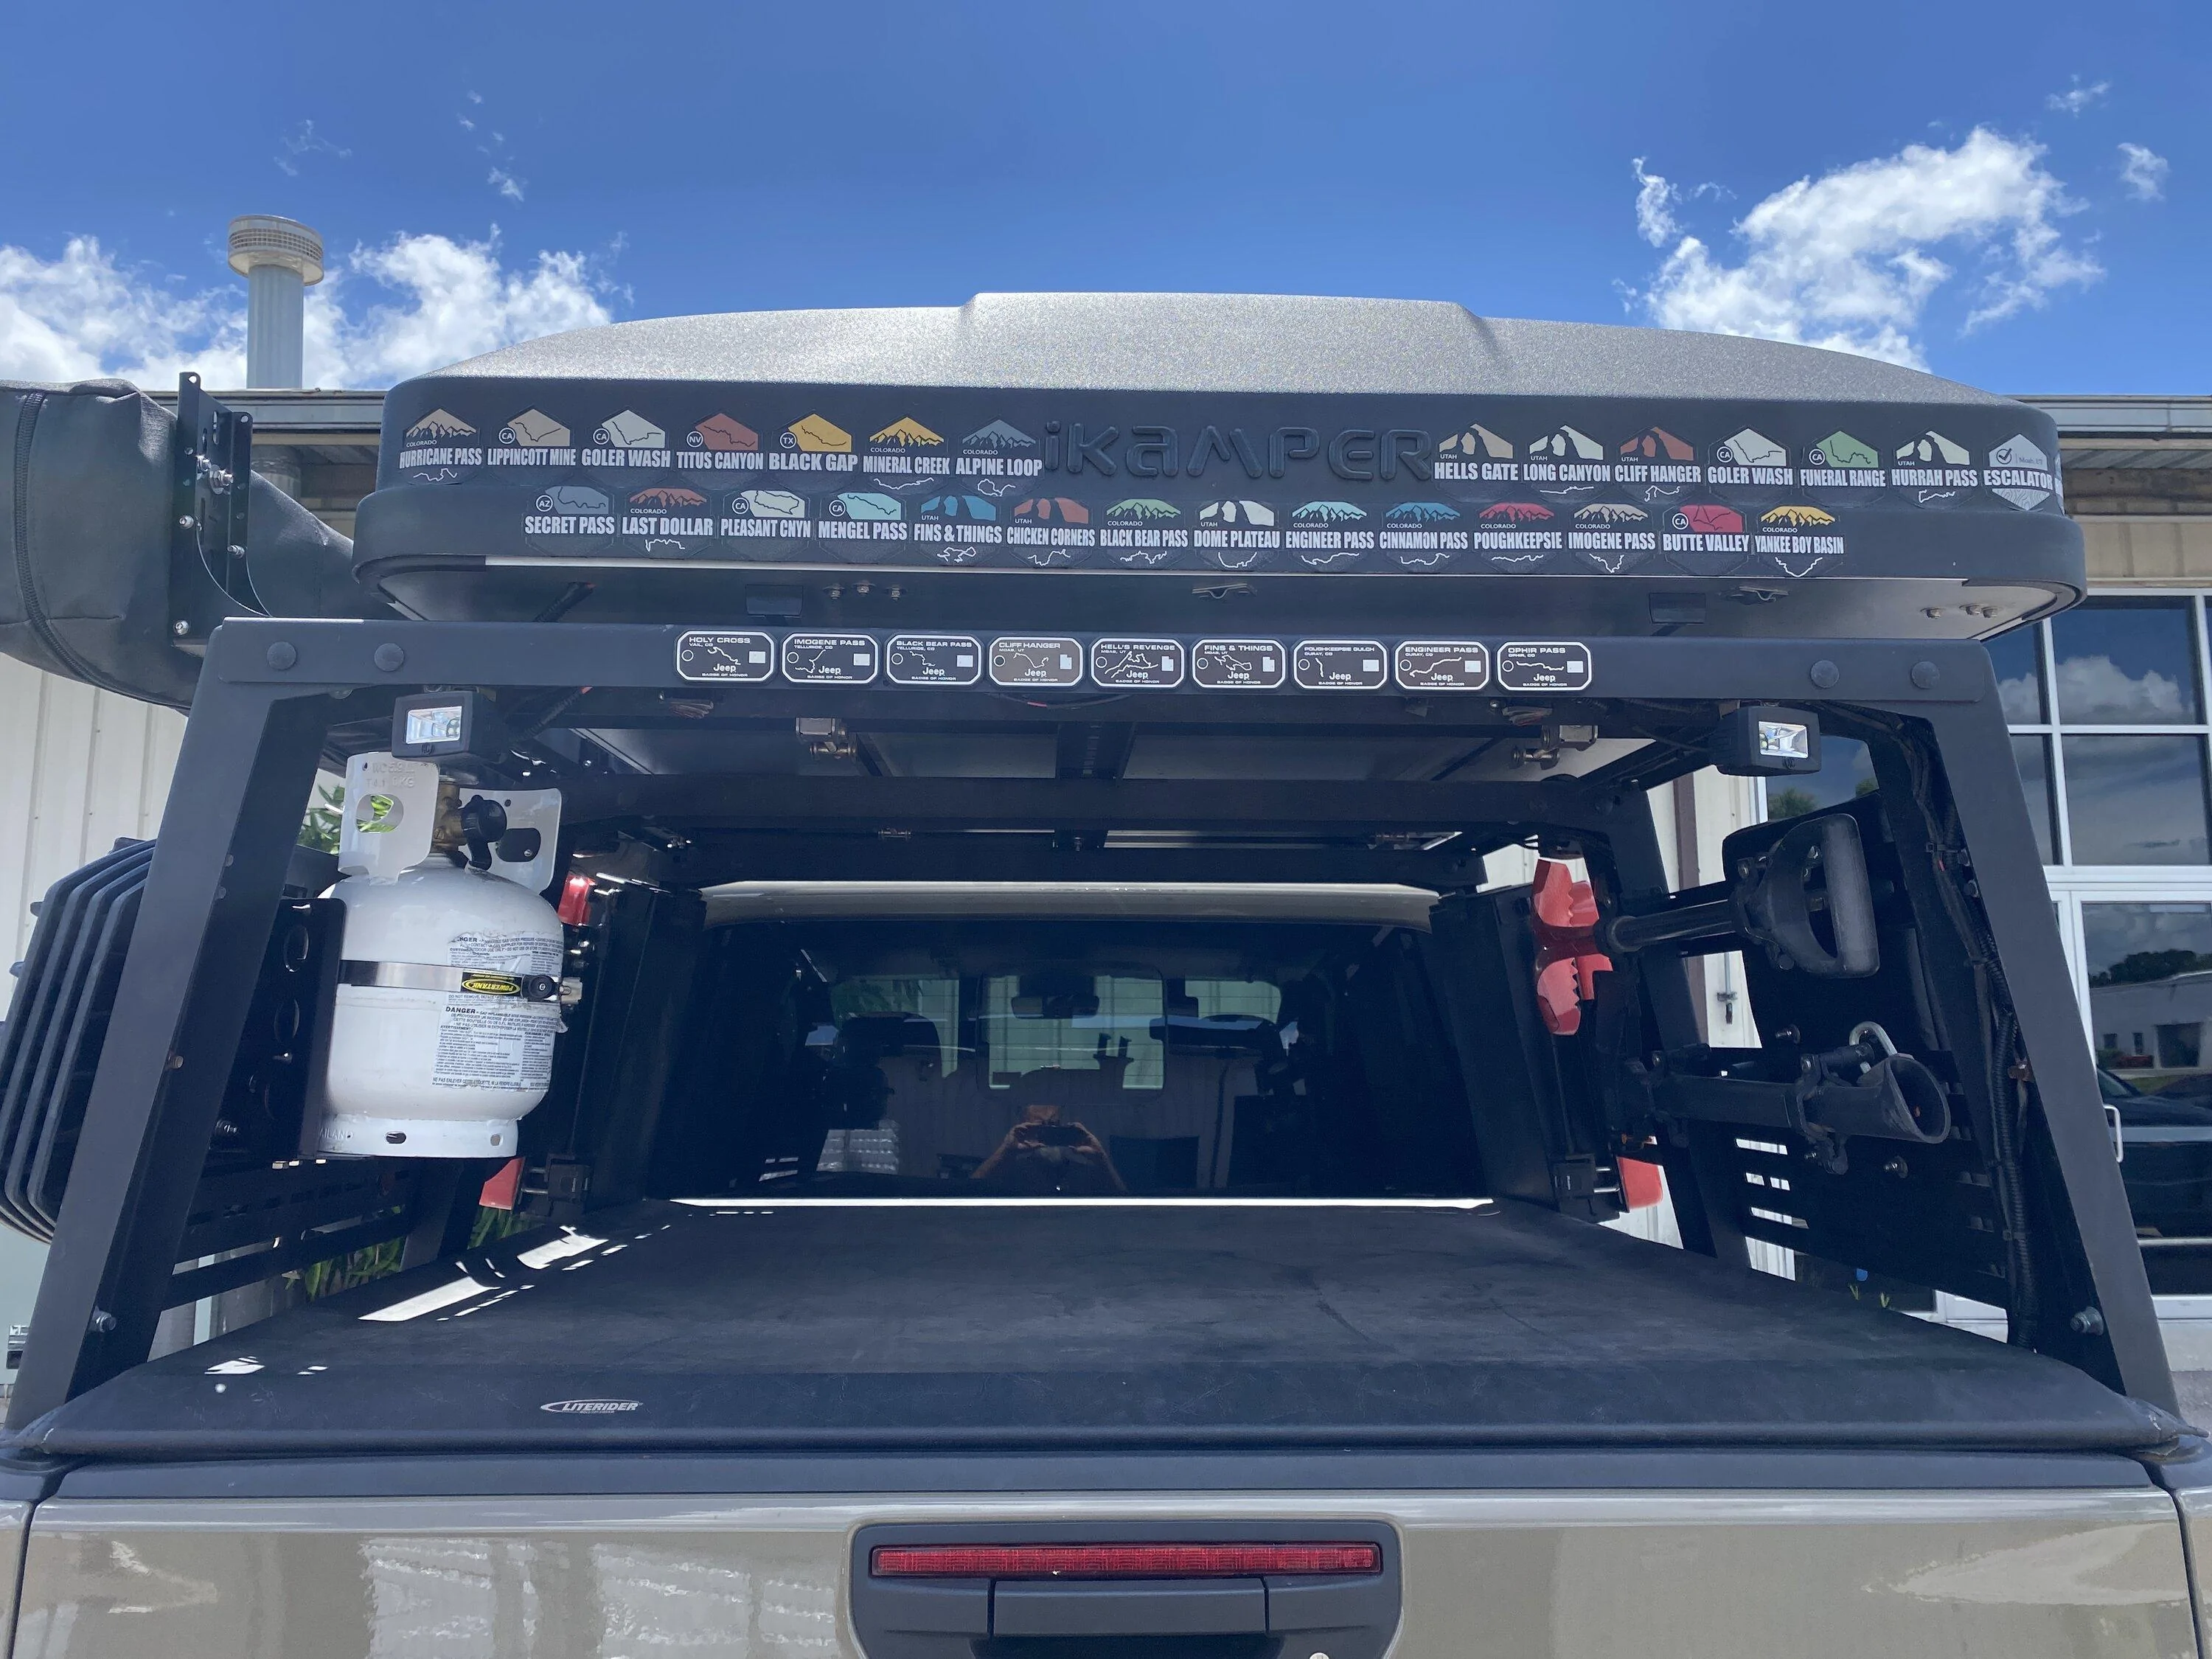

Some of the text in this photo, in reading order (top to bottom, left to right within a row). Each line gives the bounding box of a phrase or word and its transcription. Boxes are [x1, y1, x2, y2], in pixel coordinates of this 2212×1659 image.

[400, 448, 482, 469] HURRICANE PASS
[487, 448, 576, 466] LIPPINCOTT MINE
[581, 448, 670, 467] GOLER WASH
[677, 451, 763, 470] TITUS CANYON
[769, 453, 858, 471] BLACK GAP
[863, 455, 950, 475] MINERAL CREEK
[956, 458, 1043, 476] ALPINE LOOP
[1434, 462, 1519, 481] HELLS GATE
[1523, 464, 1610, 482] LONG CANYON
[1614, 465, 1702, 483] CLIFF HANGER
[1708, 467, 1793, 485] GOLER WASH
[1801, 470, 1886, 487] FUNERAL RANGE
[1891, 470, 1978, 487] HURRAH PASS
[1983, 470, 2053, 490] ESCALATOR
[524, 516, 615, 534] SECRET PASS
[622, 517, 713, 535] LAST DOLLAR
[721, 518, 810, 538] PLEASANT CNYN
[818, 521, 908, 540] MENGEL PASS
[914, 524, 1002, 543] FINS & THINGS
[1006, 526, 1096, 546] CHICKEN CORNERS
[1100, 529, 1188, 547] BLACK BEAR PASS
[1194, 530, 1280, 549] DOME PLATEAU
[1285, 531, 1374, 549] ENGINEER PASS
[1379, 532, 1468, 549] CINNAMON PASS
[1474, 532, 1562, 549] POUGHKEEPSIE
[1568, 532, 1656, 550] IMOGENE PASS
[1663, 534, 1750, 552] BUTTE VALLEY
[1754, 535, 1844, 554] YANKEE BOY BASIN
[713, 664, 737, 672] Jeep
[818, 665, 841, 675] Jeep
[922, 667, 945, 676] Jeep
[1024, 669, 1047, 678] Jeep
[1126, 670, 1149, 679] Jeep
[1228, 671, 1250, 680] Jeep
[1329, 672, 1352, 681] Jeep
[1430, 672, 1453, 682] Jeep
[1534, 673, 1556, 683] Jeep
[562, 1402, 639, 1411] LITERIDER
